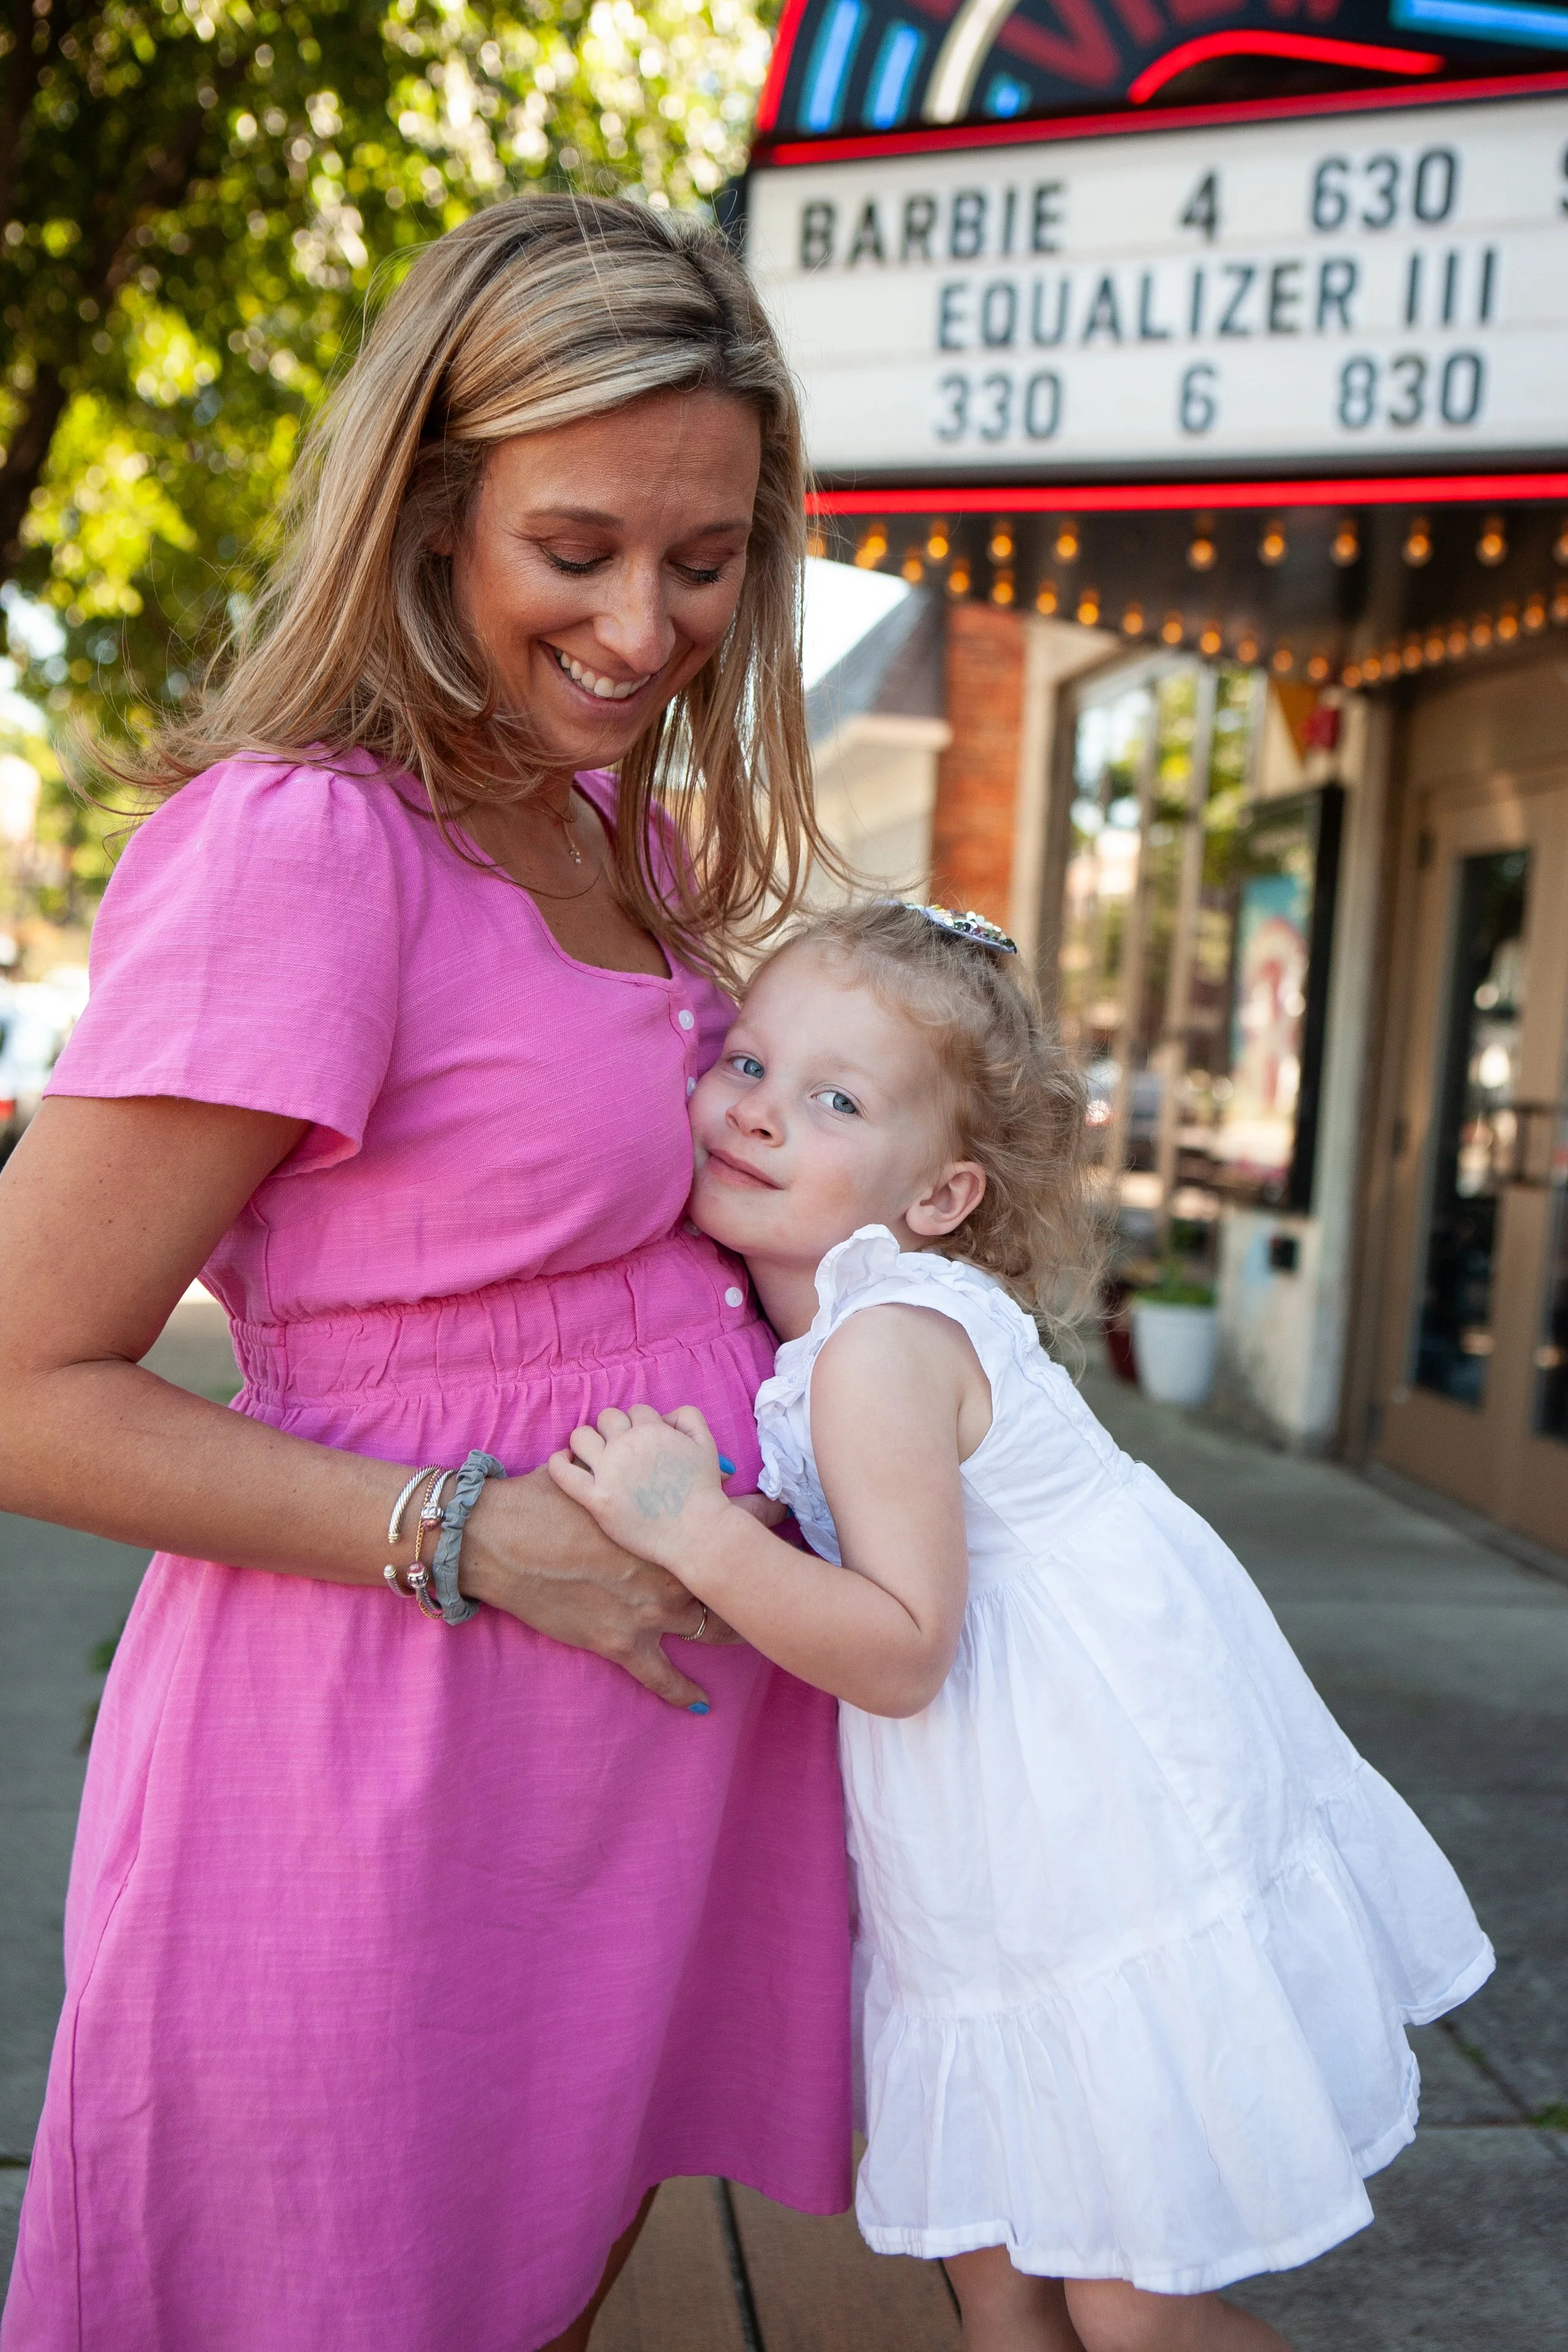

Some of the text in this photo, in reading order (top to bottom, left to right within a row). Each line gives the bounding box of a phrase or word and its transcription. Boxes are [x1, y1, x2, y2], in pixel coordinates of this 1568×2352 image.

[801, 148, 1458, 270] BARBIE 4 630
[938, 248, 1497, 351] EQUALIZER III
[937, 352, 1485, 442] 330 6 830
